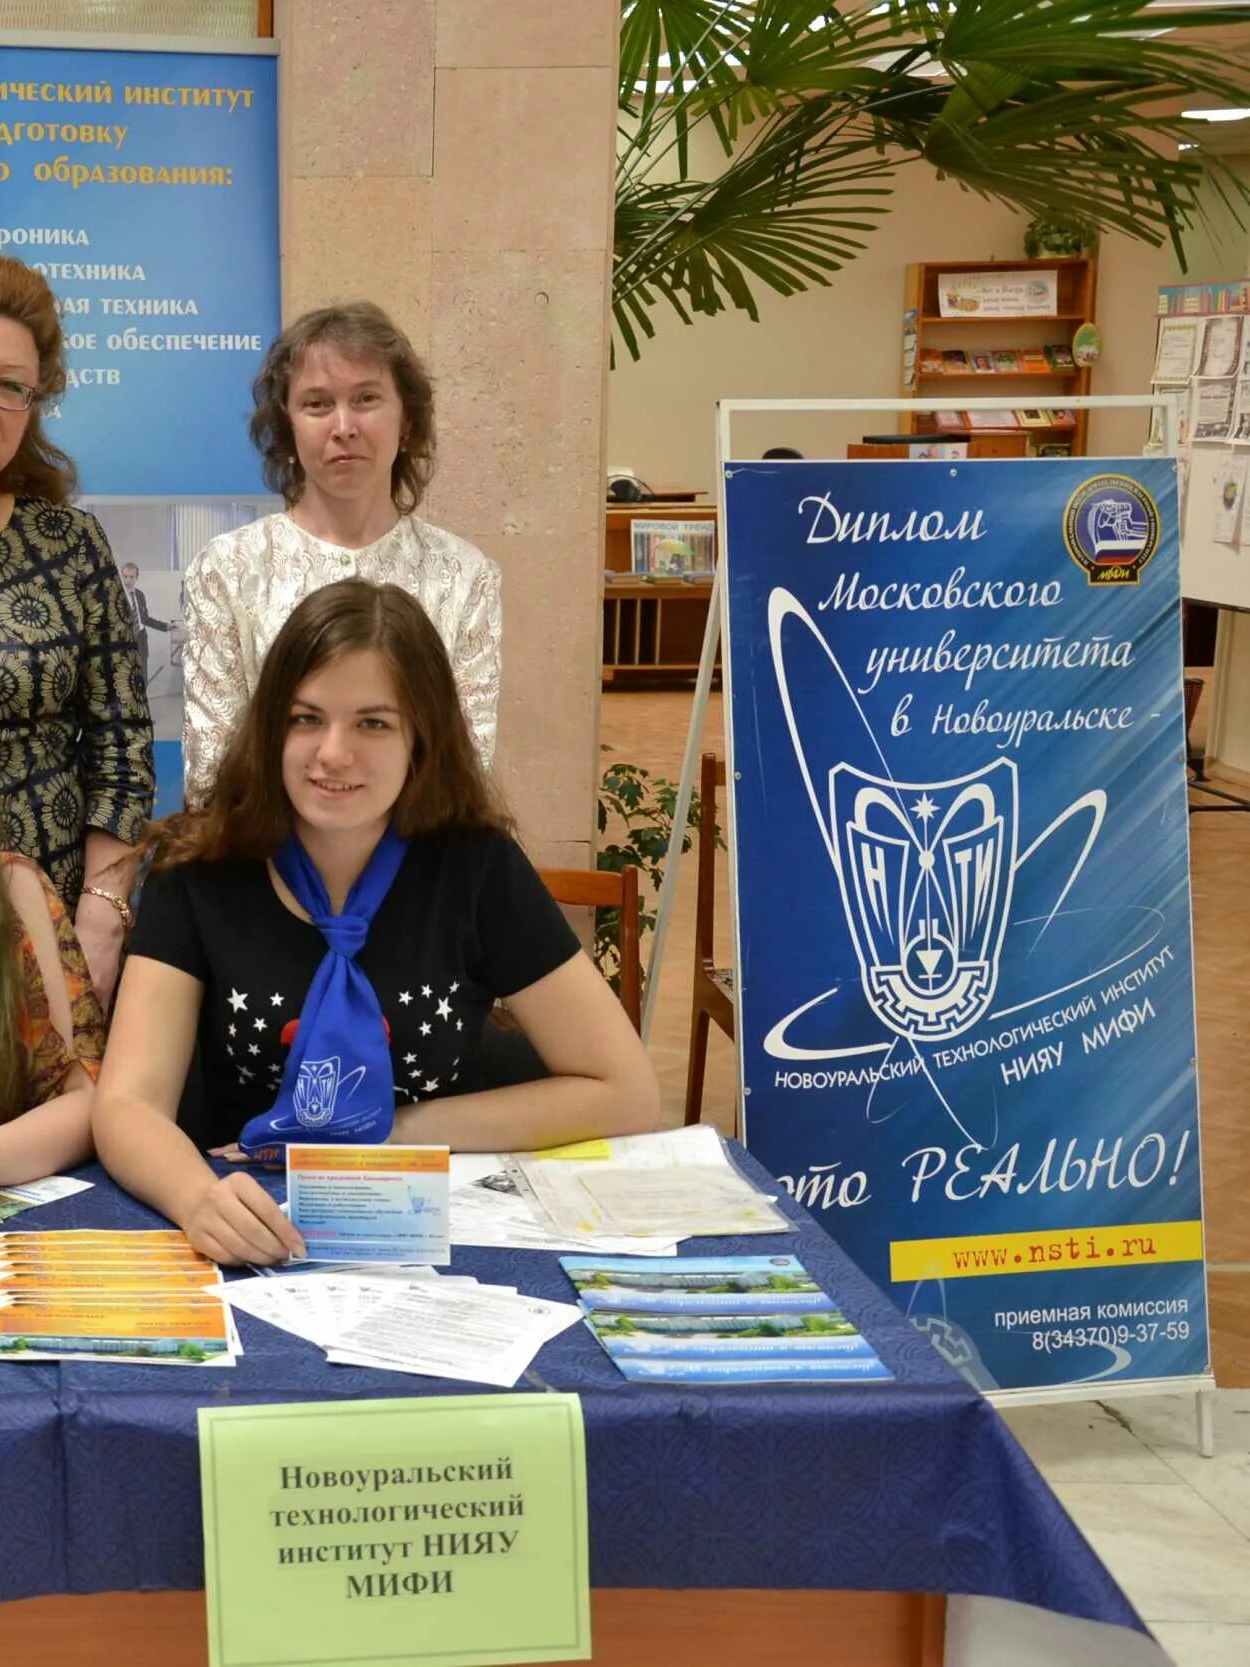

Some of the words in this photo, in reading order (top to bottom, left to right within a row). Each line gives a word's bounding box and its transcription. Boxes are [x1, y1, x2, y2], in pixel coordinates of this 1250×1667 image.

[123, 85, 255, 113] институт
[34, 154, 237, 190] образования:
[100, 298, 199, 316] техника
[106, 326, 263, 351] обеспечение
[797, 490, 988, 545] Диплом
[817, 566, 1065, 612] Московского
[857, 629, 1134, 695] университета
[891, 694, 910, 737] в
[931, 699, 1135, 749] Новоуральске
[774, 1051, 928, 1089] НОВОУРАЛЬСКИЙ
[932, 995, 1097, 1069] ТЕХНОЛОГИЧЕСКИЙ
[1099, 944, 1176, 1008] ИНСТИТУТ
[999, 1041, 1065, 1087] НИЯУ
[1080, 996, 1157, 1055] МИФИ
[901, 1130, 1191, 1203] РЕАЛЬНО!
[951, 1234, 1158, 1271] www.nsti.ru
[994, 1304, 1092, 1329] приемная
[1096, 1297, 1189, 1321] комиссия
[1031, 1319, 1190, 1353] 8(34370)9-37-59
[280, 1455, 513, 1494] Новоуральский
[269, 1494, 525, 1529] технологический
[278, 1537, 413, 1568] институт
[422, 1528, 520, 1560] НИЯУ
[346, 1568, 455, 1602] МИФИ
